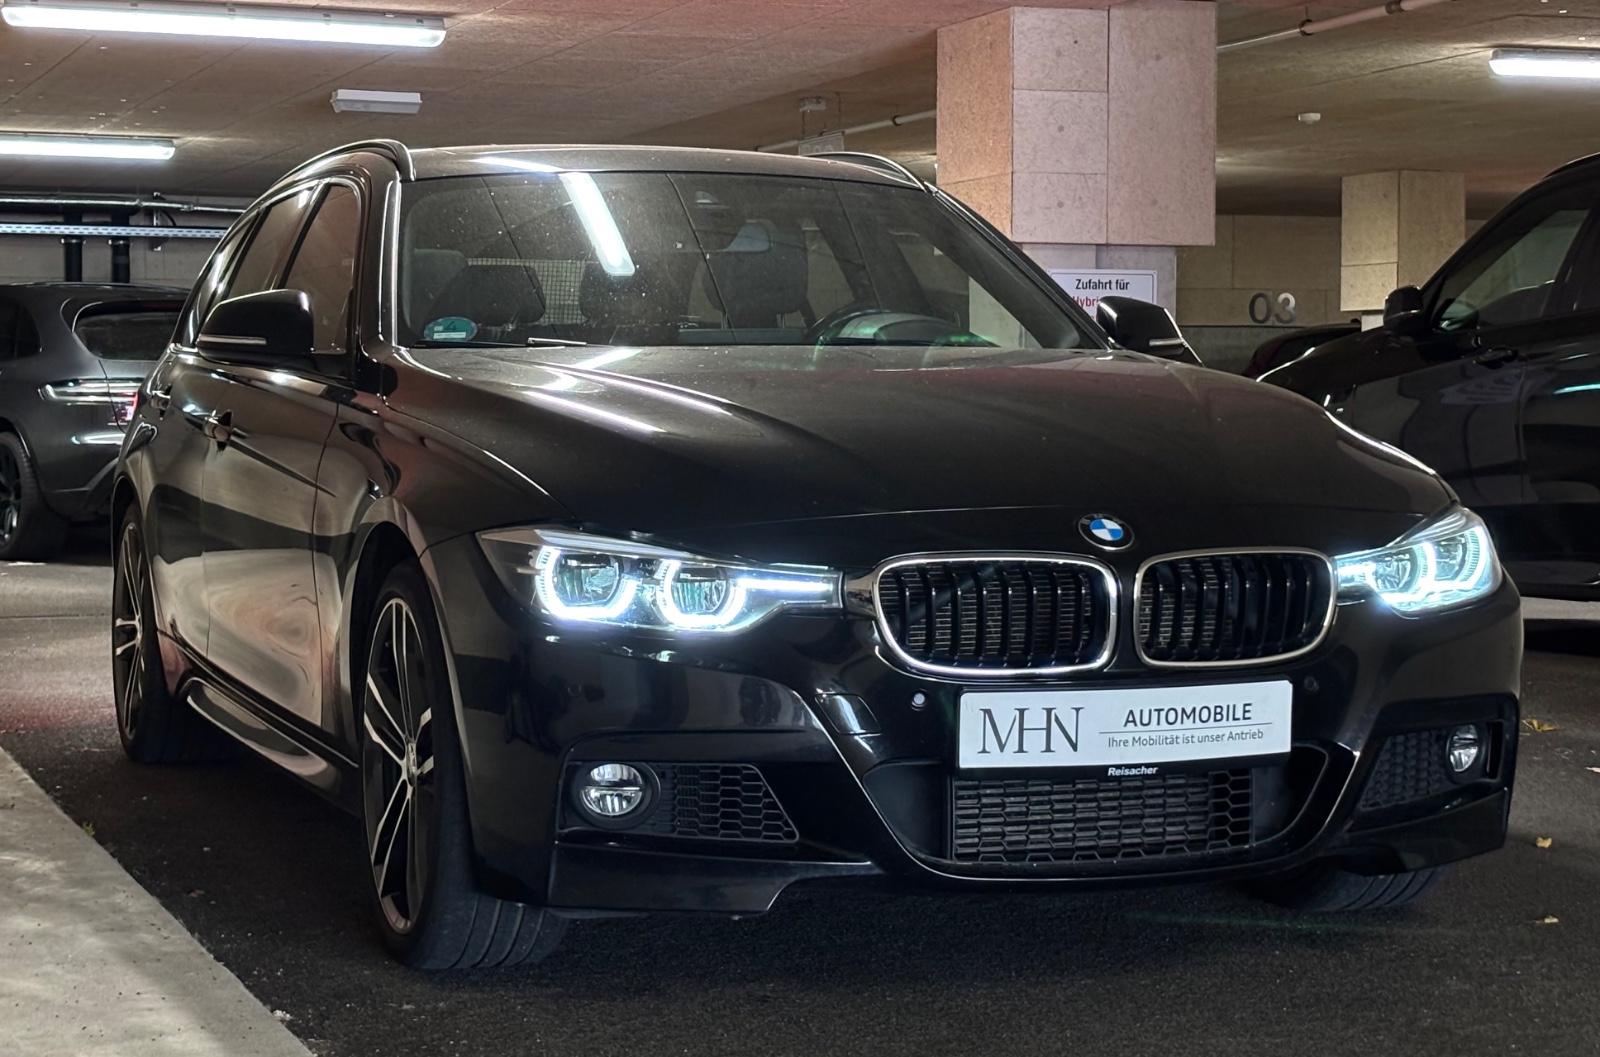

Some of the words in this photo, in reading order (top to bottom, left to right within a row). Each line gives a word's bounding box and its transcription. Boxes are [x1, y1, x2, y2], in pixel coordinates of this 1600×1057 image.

[1075, 279, 1112, 290] Zufahrt
[1115, 279, 1130, 290] für
[1249, 292, 1296, 324] 03
[1123, 703, 1252, 727] AUTOMOBILE
[977, 706, 1085, 754] MHN
[1108, 737, 1129, 748] Ihre
[1132, 733, 1180, 747] Mobilität
[1182, 733, 1195, 744] ist
[1199, 733, 1225, 743] unser
[1228, 729, 1264, 742] Antrieb
[1107, 767, 1158, 776] Reisacher
